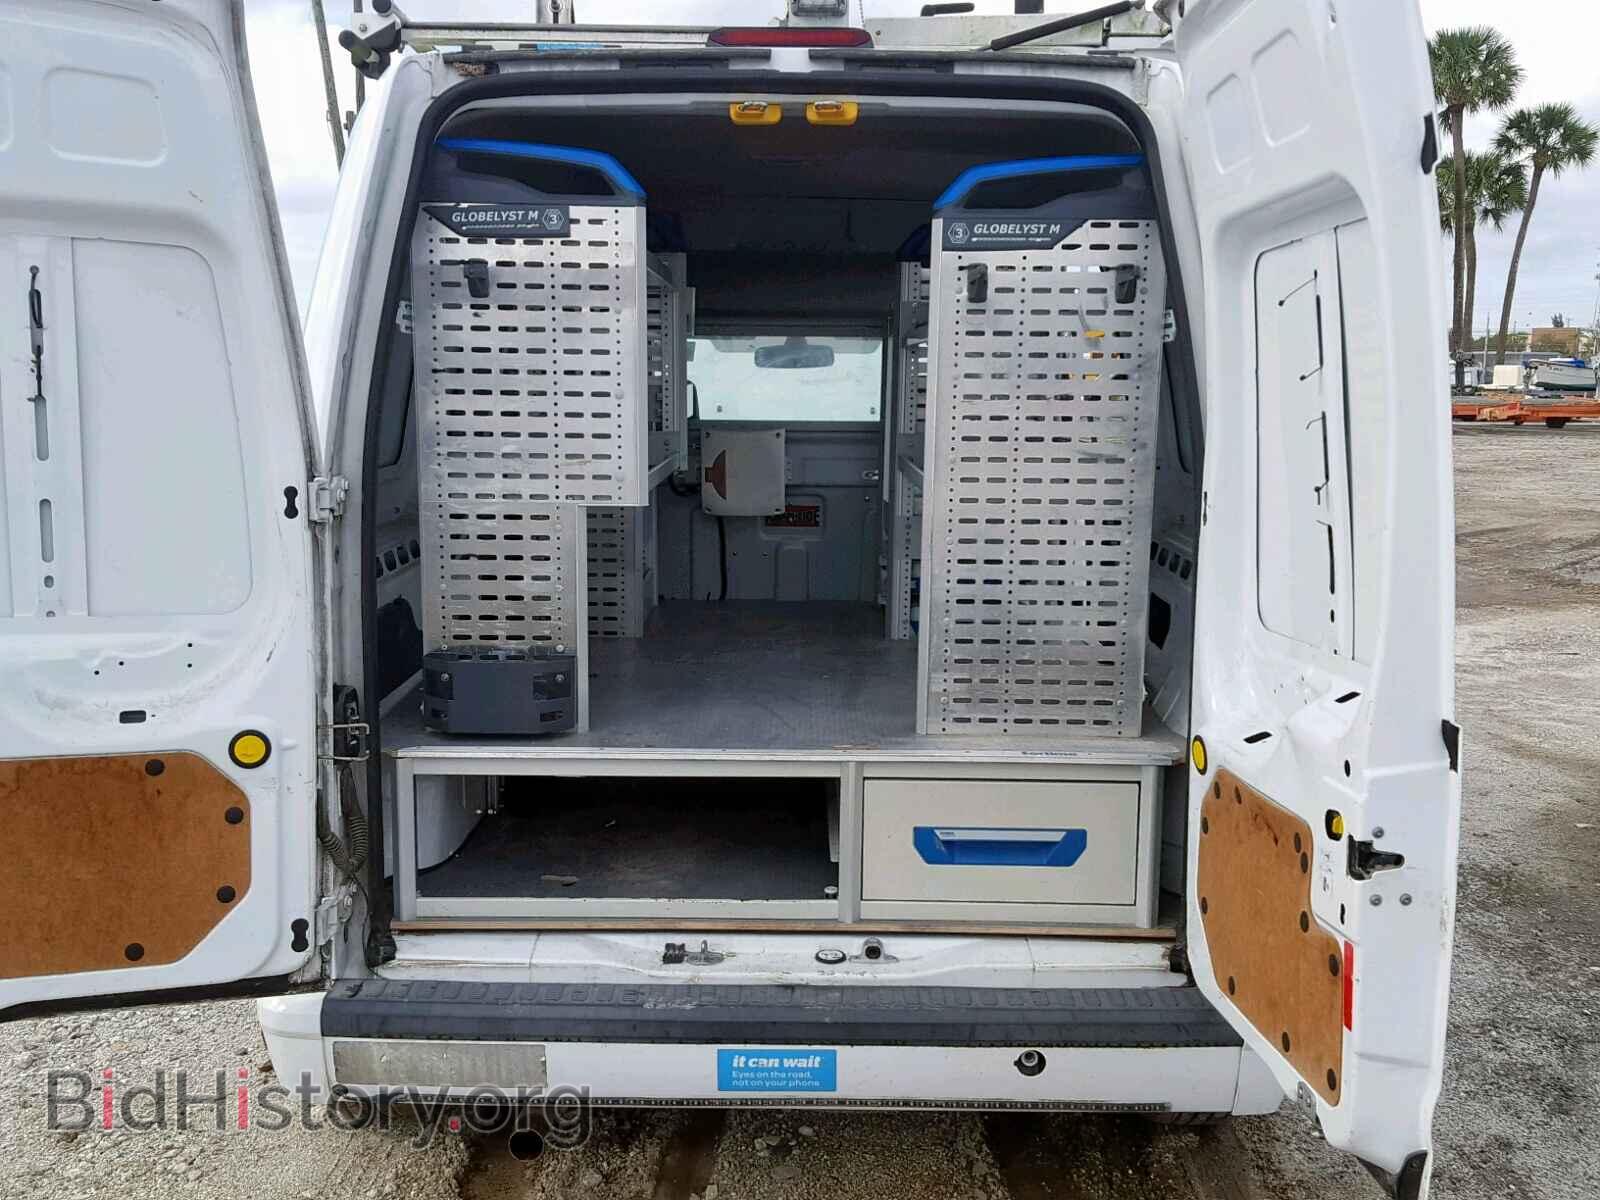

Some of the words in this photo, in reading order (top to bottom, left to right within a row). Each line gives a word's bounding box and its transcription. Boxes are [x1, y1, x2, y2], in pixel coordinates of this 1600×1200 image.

[452, 210, 523, 222] GLOBELYST
[528, 210, 539, 221] M
[549, 214, 558, 224] 3
[955, 227, 963, 238] 3
[974, 223, 1047, 234] GLOBELYST
[1049, 223, 1061, 234] M
[732, 1054, 746, 1068] it
[748, 1056, 780, 1068] can
[783, 1055, 822, 1068] wait
[732, 1071, 755, 1080] Eyes
[769, 1070, 786, 1079] the
[732, 1079, 749, 1087] not
[751, 1079, 763, 1087] on
[764, 1080, 787, 1089] your
